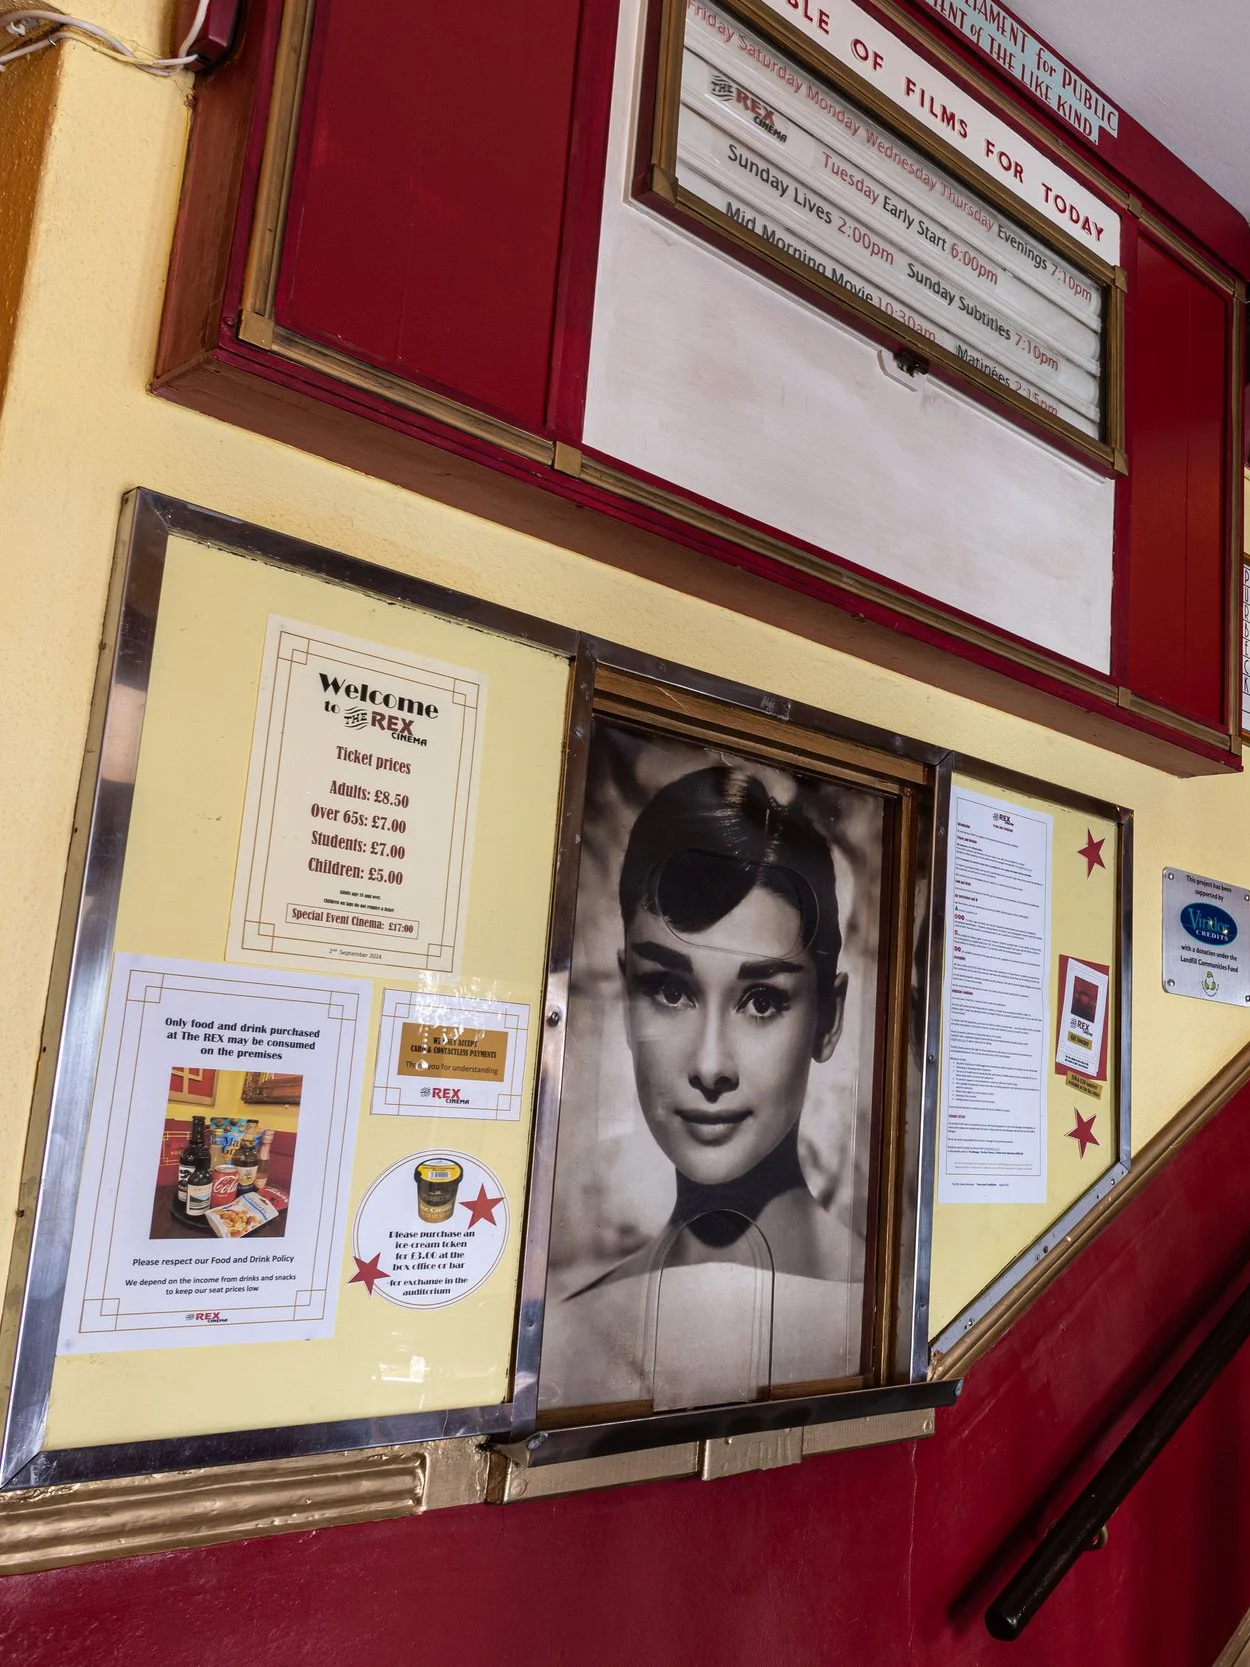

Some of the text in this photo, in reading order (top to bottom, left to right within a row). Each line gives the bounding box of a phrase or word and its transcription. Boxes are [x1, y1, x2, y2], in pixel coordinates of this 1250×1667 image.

[970, 24, 1097, 143] of THE LIKE KIND.
[1036, 47, 1117, 132] for PUBLIC
[735, 88, 775, 126] REX
[753, 115, 787, 143] CINEMA
[851, 38, 1104, 242] OF FILMS FOR TODAY
[687, 1, 1092, 302] Friday Saturday Monday Wednesday Thursday Evenings 7:10pm
[728, 144, 894, 265] Sunday Lives 2:00pm
[822, 151, 998, 285] Tuesday Early Start 6:00pm
[726, 201, 756, 231] Mid
[762, 224, 826, 275] Morning
[831, 267, 873, 302] Movie
[907, 262, 1059, 372] Sunday Subtitles 7:10pm
[319, 672, 439, 719] Welcome
[324, 700, 415, 736] to THE REX
[391, 732, 427, 746] CINEMA
[336, 745, 411, 775] Ticket prices
[329, 780, 409, 808] Adults: £8.50
[310, 803, 407, 834] Over 65s: £7.00
[999, 813, 1011, 822] REX
[311, 830, 405, 859] Students: £7.00
[308, 857, 403, 885] Children: £5.00
[1186, 874, 1196, 883] This
[1197, 879, 1212, 887] project
[1213, 882, 1221, 890] has
[1195, 889, 1224, 902] supported by
[292, 907, 414, 933] Special Event Cinema: £17:00
[1187, 907, 1230, 932] Viridor
[1195, 929, 1229, 941] CREDITS
[339, 949, 382, 960] September 2024
[1196, 947, 1216, 956] donation
[1180, 955, 1238, 973] Landfill Communities Fund
[165, 1017, 320, 1039] Only food and drink purchased
[1077, 1020, 1090, 1030] REX
[166, 1031, 316, 1050] at The REX may be consumed
[459, 1039, 478, 1047] ACCEPT
[200, 1046, 283, 1061] on the premises
[433, 1047, 469, 1057] CONTACTLESS
[470, 1049, 497, 1058] PAYMENTS
[441, 1063, 451, 1071] for
[452, 1066, 498, 1075] understanding
[432, 1088, 461, 1099] REX
[420, 1230, 462, 1239] purchase
[442, 1240, 467, 1248] token
[132, 1258, 160, 1266] Please
[162, 1257, 193, 1267] respect
[211, 1256, 231, 1264] Food
[233, 1256, 248, 1264] and
[249, 1255, 270, 1263] Drink
[272, 1254, 295, 1264] Policy
[395, 1252, 408, 1260] for
[410, 1251, 438, 1260] £3.00
[392, 1263, 410, 1271] box
[412, 1262, 436, 1270] office
[449, 1261, 465, 1269] bar
[125, 1278, 138, 1286] We
[139, 1278, 166, 1287] depend
[220, 1275, 238, 1283] from
[239, 1274, 259, 1282] drinks
[275, 1273, 296, 1281] snacks
[404, 1278, 443, 1286] exchange
[175, 1287, 193, 1295] keep
[225, 1286, 245, 1294] prices
[402, 1287, 451, 1296] auditorium
[195, 1311, 221, 1321] REX
